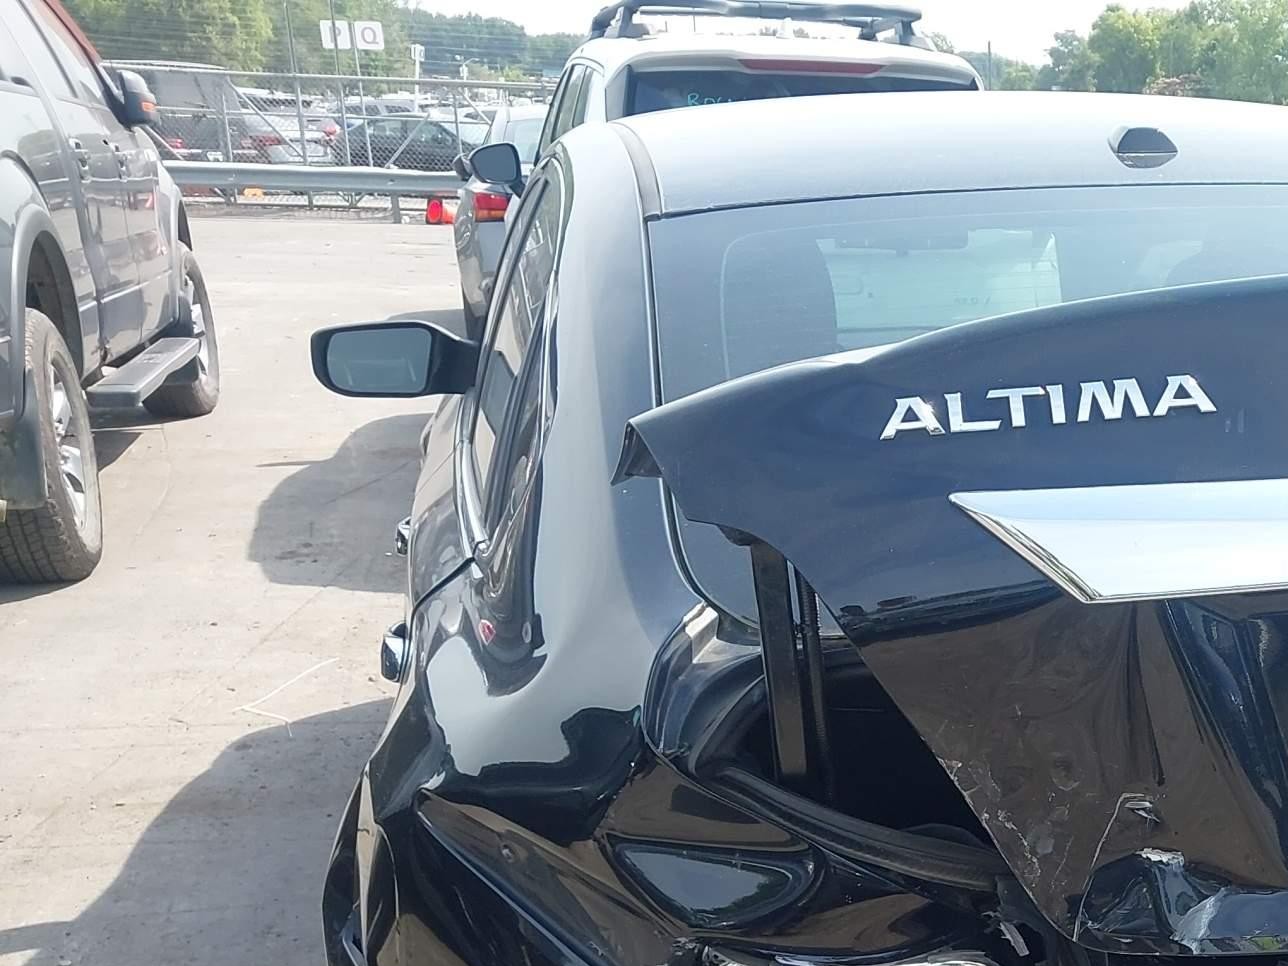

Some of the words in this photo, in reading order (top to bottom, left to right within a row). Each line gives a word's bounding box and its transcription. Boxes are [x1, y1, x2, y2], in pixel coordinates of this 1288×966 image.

[327, 25, 342, 45] P
[360, 26, 380, 45] Q
[879, 374, 1218, 441] ALTIMA
